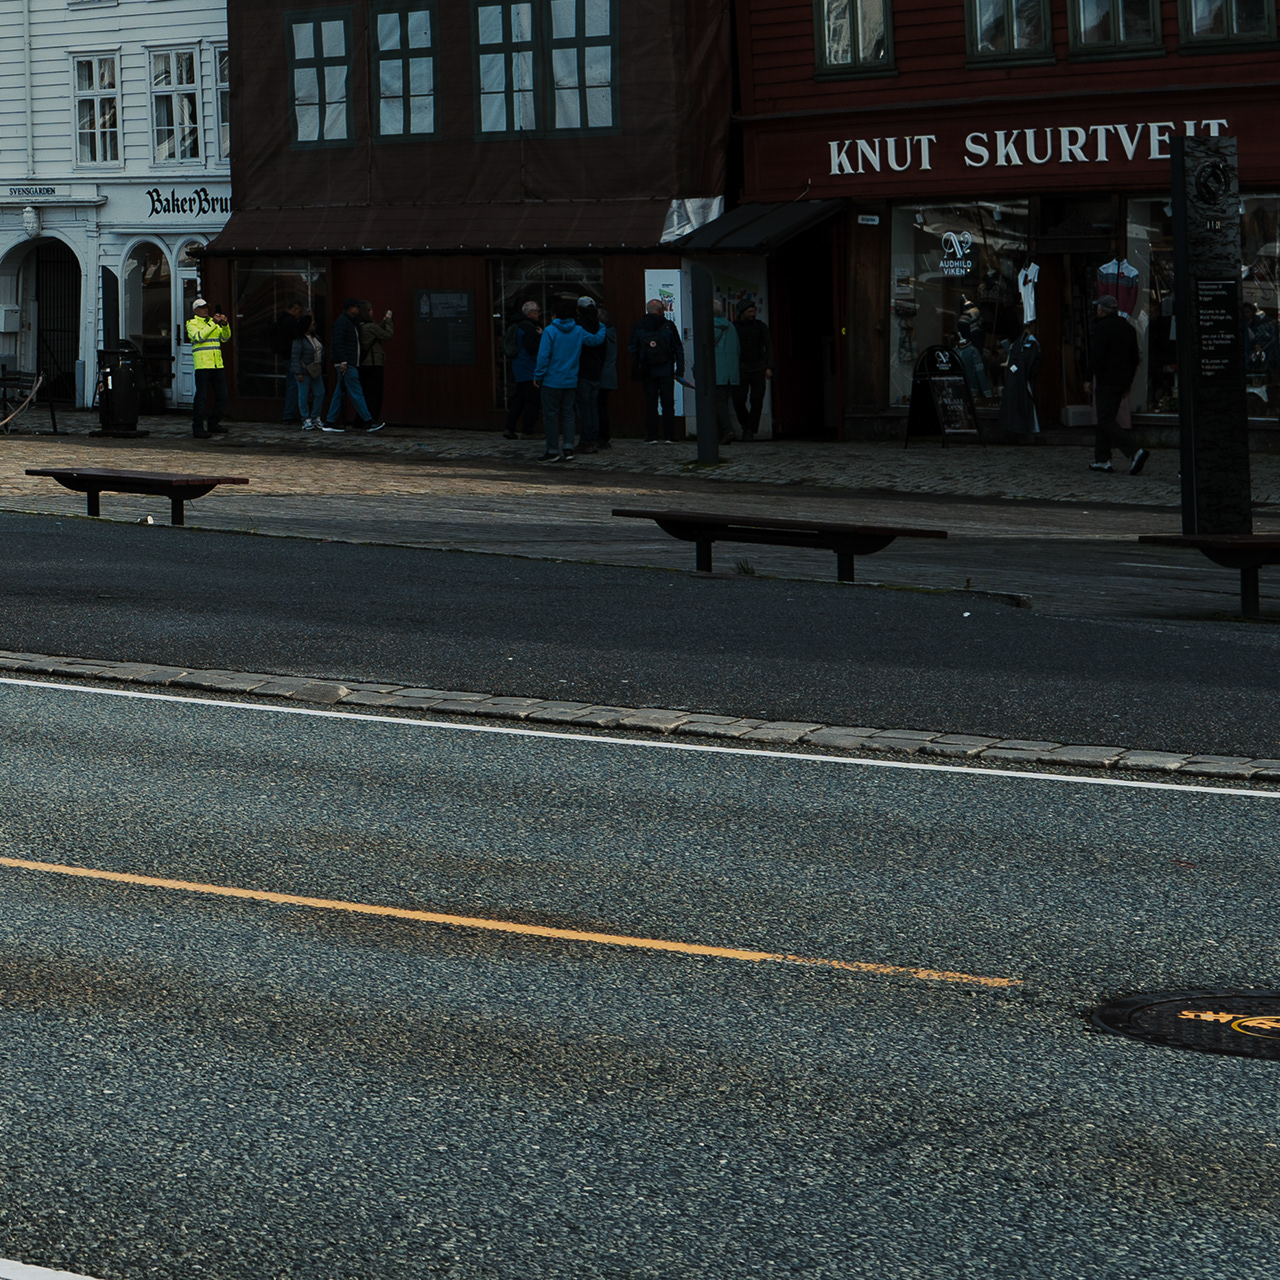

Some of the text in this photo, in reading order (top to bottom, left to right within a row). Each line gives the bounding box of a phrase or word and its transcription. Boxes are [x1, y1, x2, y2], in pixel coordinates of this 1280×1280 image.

[827, 134, 937, 175] KNUT
[9, 187, 56, 196] SVENSGARDEN
[939, 260, 972, 268] AUDHILD
